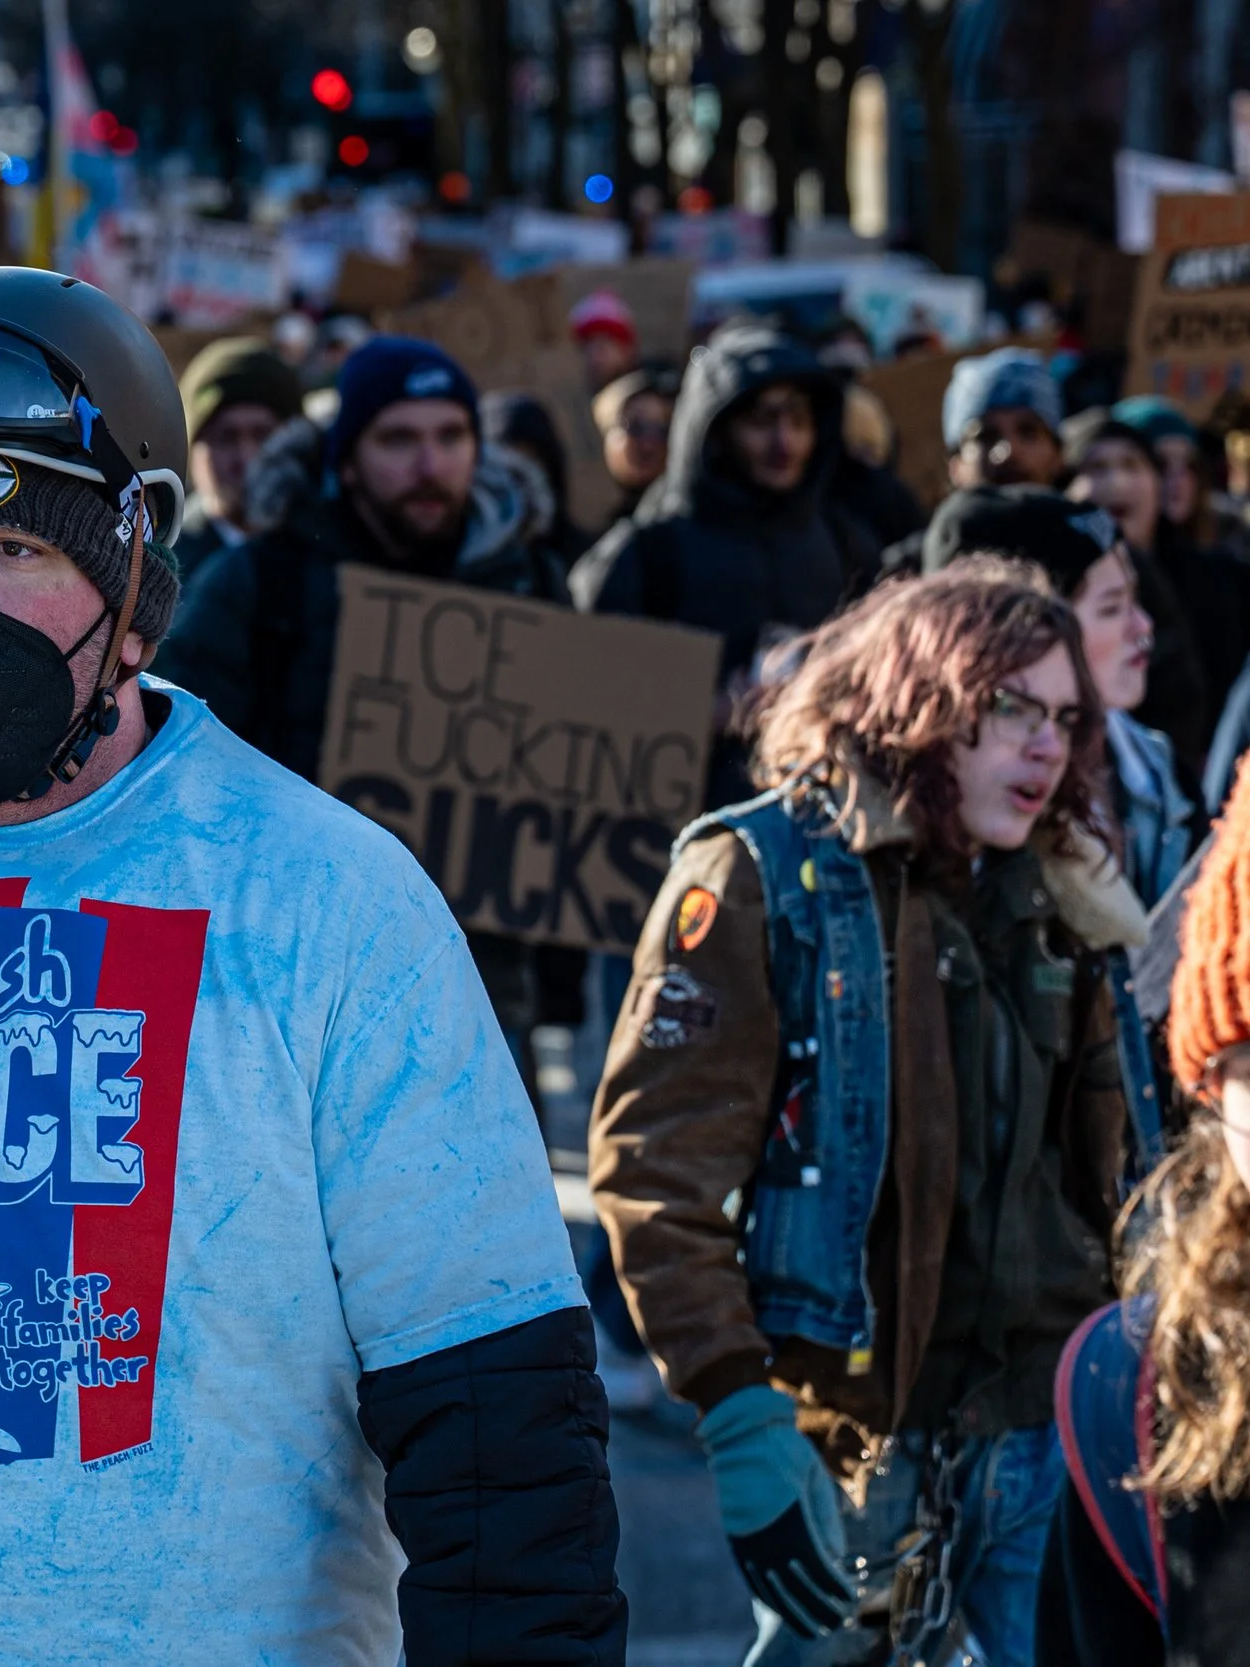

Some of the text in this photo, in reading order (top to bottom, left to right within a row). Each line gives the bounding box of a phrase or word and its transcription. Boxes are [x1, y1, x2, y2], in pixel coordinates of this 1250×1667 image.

[354, 587, 540, 714] ICE
[339, 686, 699, 814] FUCKING
[35, 1269, 110, 1306] keep
[1, 1302, 140, 1350] families
[83, 1442, 154, 1473] THE PEACH FUZZ
